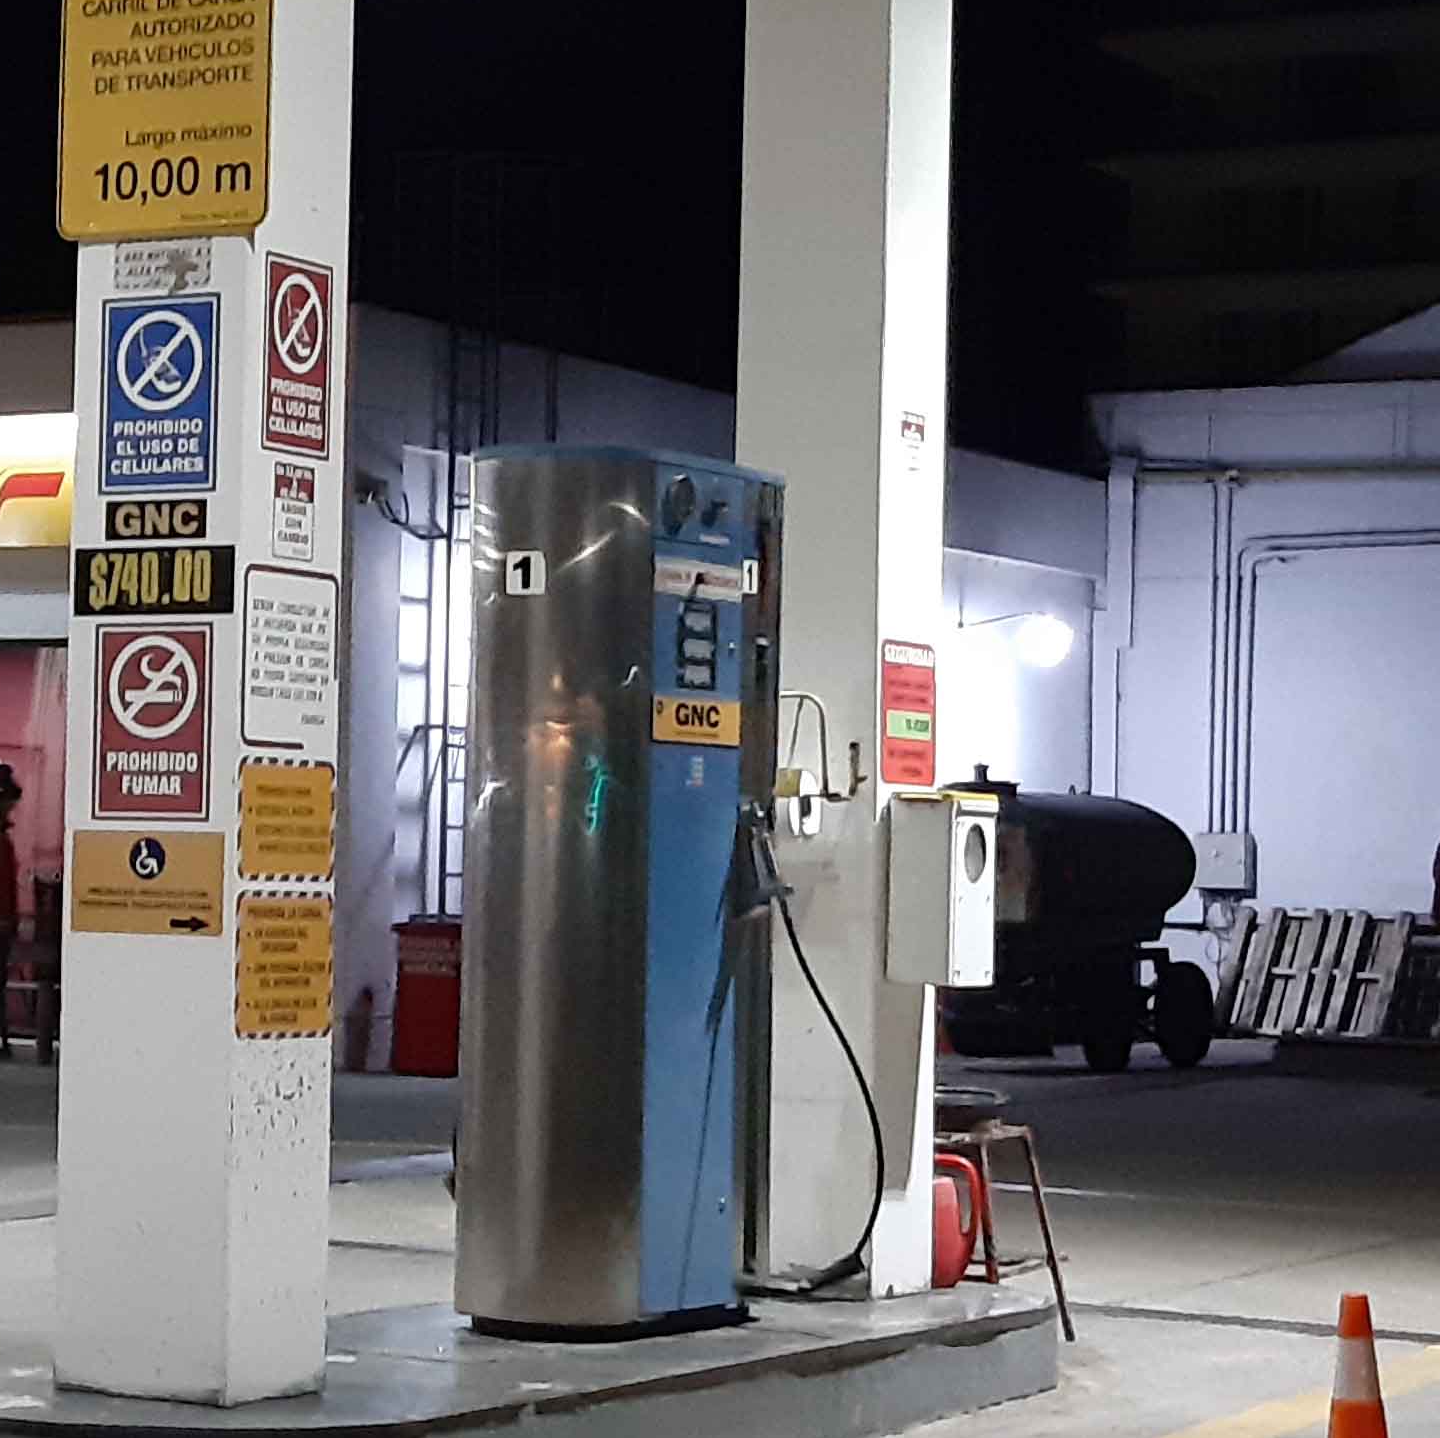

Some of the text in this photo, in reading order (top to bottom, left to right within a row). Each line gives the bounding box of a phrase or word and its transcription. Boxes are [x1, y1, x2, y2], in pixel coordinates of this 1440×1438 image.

[130, 11, 255, 40] AUTORIZADO
[91, 37, 255, 68] PARA VEHICULOS
[95, 64, 253, 95] DE TRANSPORTE
[125, 121, 252, 150] Largo máximo
[94, 156, 251, 206] 10,00 m
[286, 400, 306, 418] USO
[113, 418, 203, 438] PROHIBIDO
[116, 436, 199, 456] EL USO DE
[110, 456, 204, 475] CELULARES
[115, 503, 199, 536] GNC
[89, 549, 212, 610] $740.00
[512, 556, 531, 590] 1
[746, 563, 753, 591] 1
[675, 703, 720, 728] GNC
[106, 750, 198, 772] PROHIBIDO
[121, 774, 182, 796] FUMAR
